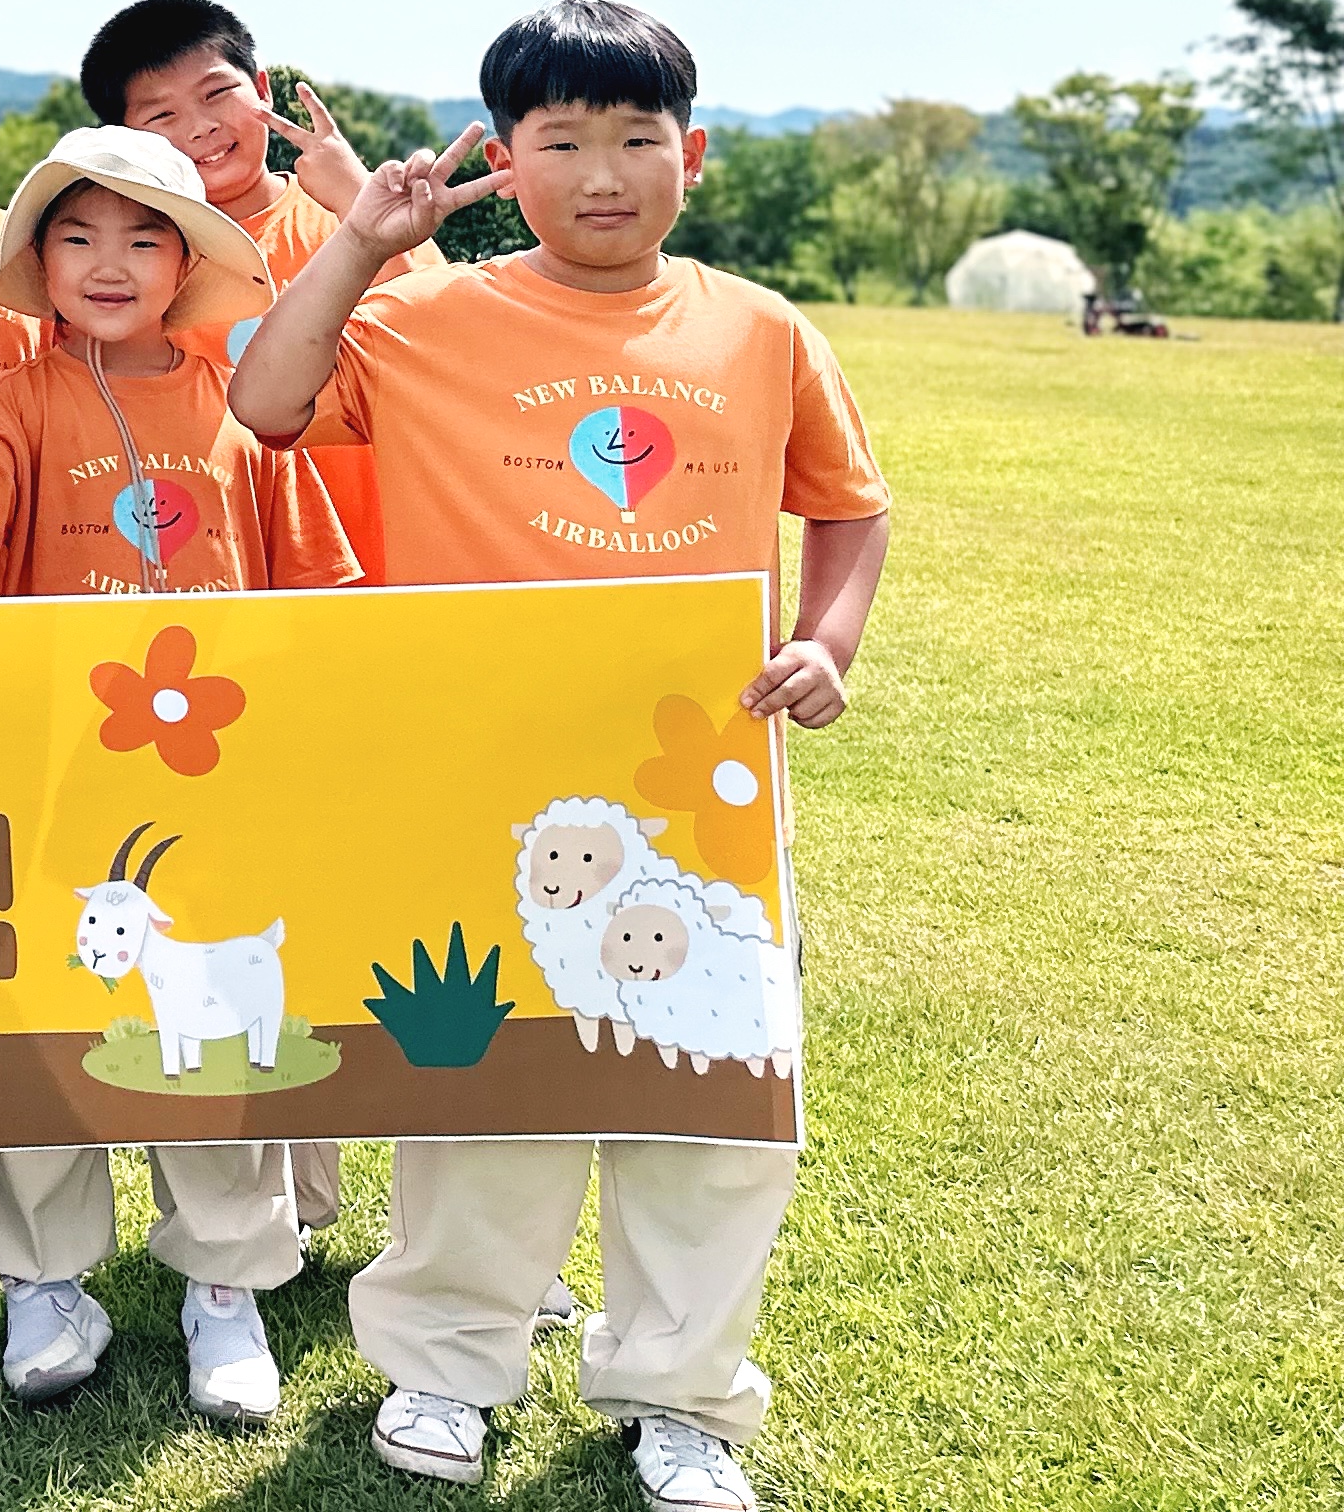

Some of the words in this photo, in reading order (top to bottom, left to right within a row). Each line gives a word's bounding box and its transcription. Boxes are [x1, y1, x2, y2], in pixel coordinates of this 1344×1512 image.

[513, 378, 577, 413] NEW
[587, 374, 727, 415] BALANCE
[68, 455, 119, 485] NEW
[138, 453, 235, 491] ALANCE
[503, 455, 564, 471] BOSTON
[684, 461, 705, 474] MA
[713, 461, 739, 474] USA
[61, 524, 109, 535] BOSTON
[528, 510, 718, 553] AIRBALLOON
